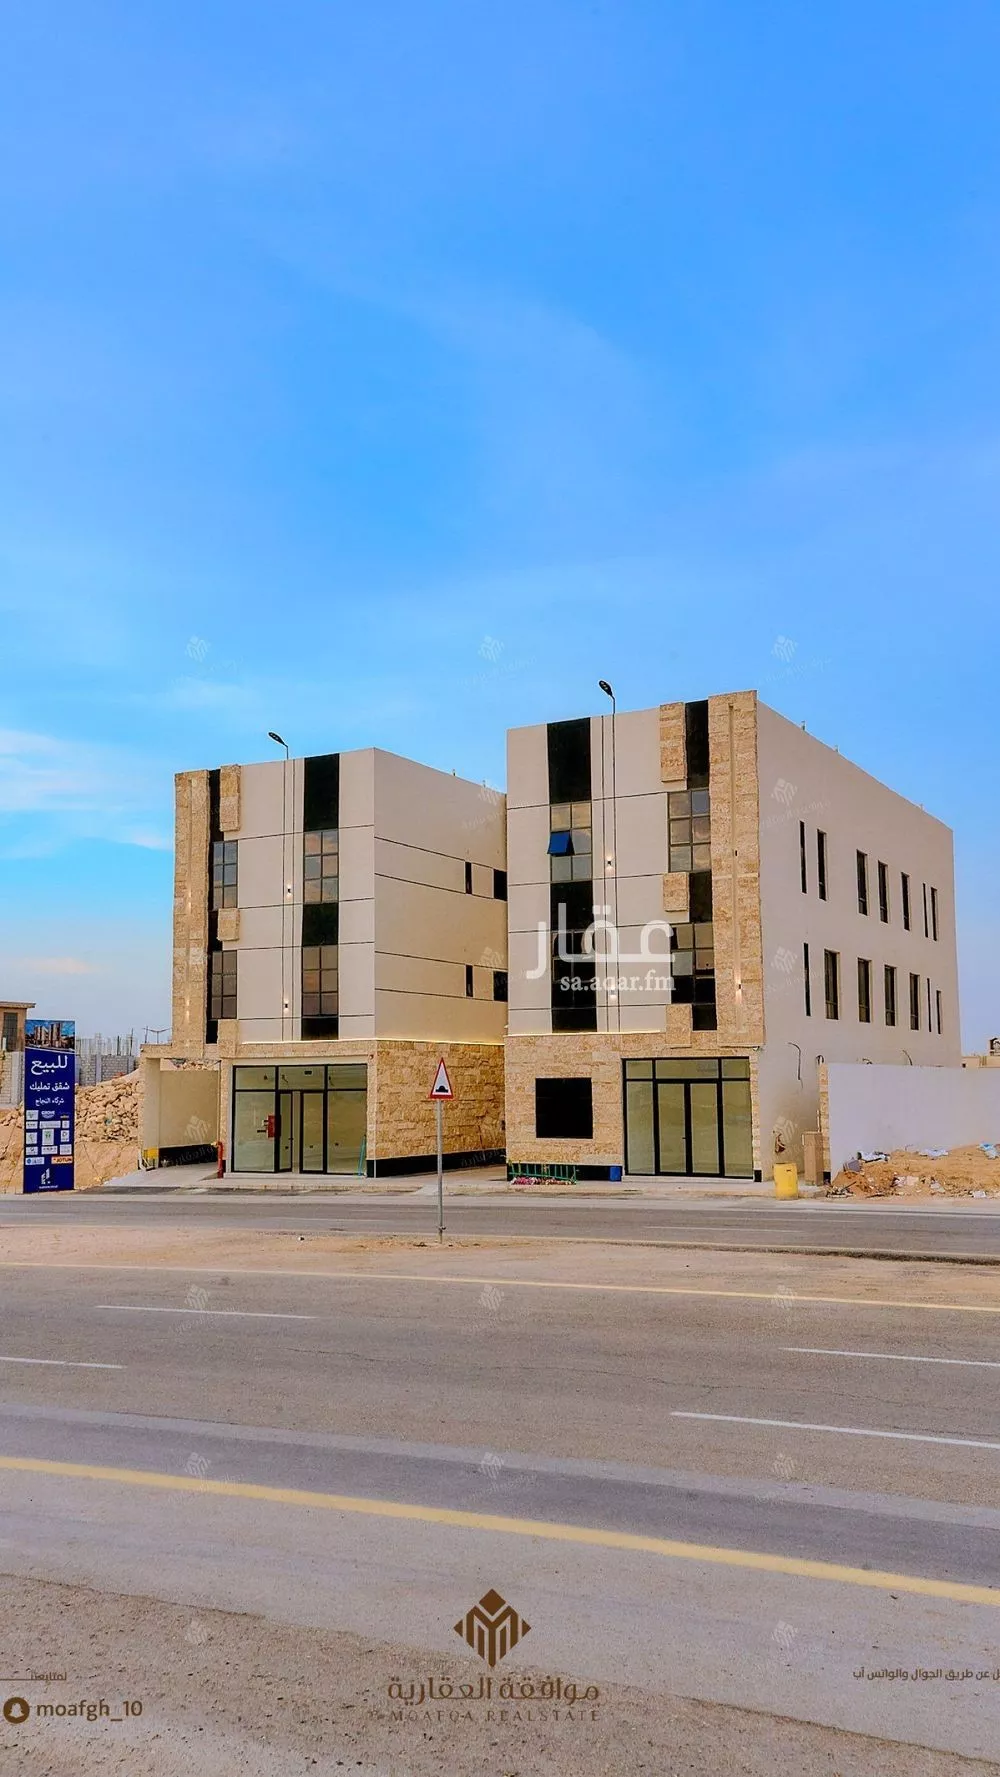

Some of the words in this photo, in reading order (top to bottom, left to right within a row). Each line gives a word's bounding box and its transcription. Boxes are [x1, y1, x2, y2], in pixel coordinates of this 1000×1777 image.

[30, 1055, 68, 1075] للبيع
[29, 1081, 51, 1092] تمليك
[51, 1081, 70, 1092] شقق
